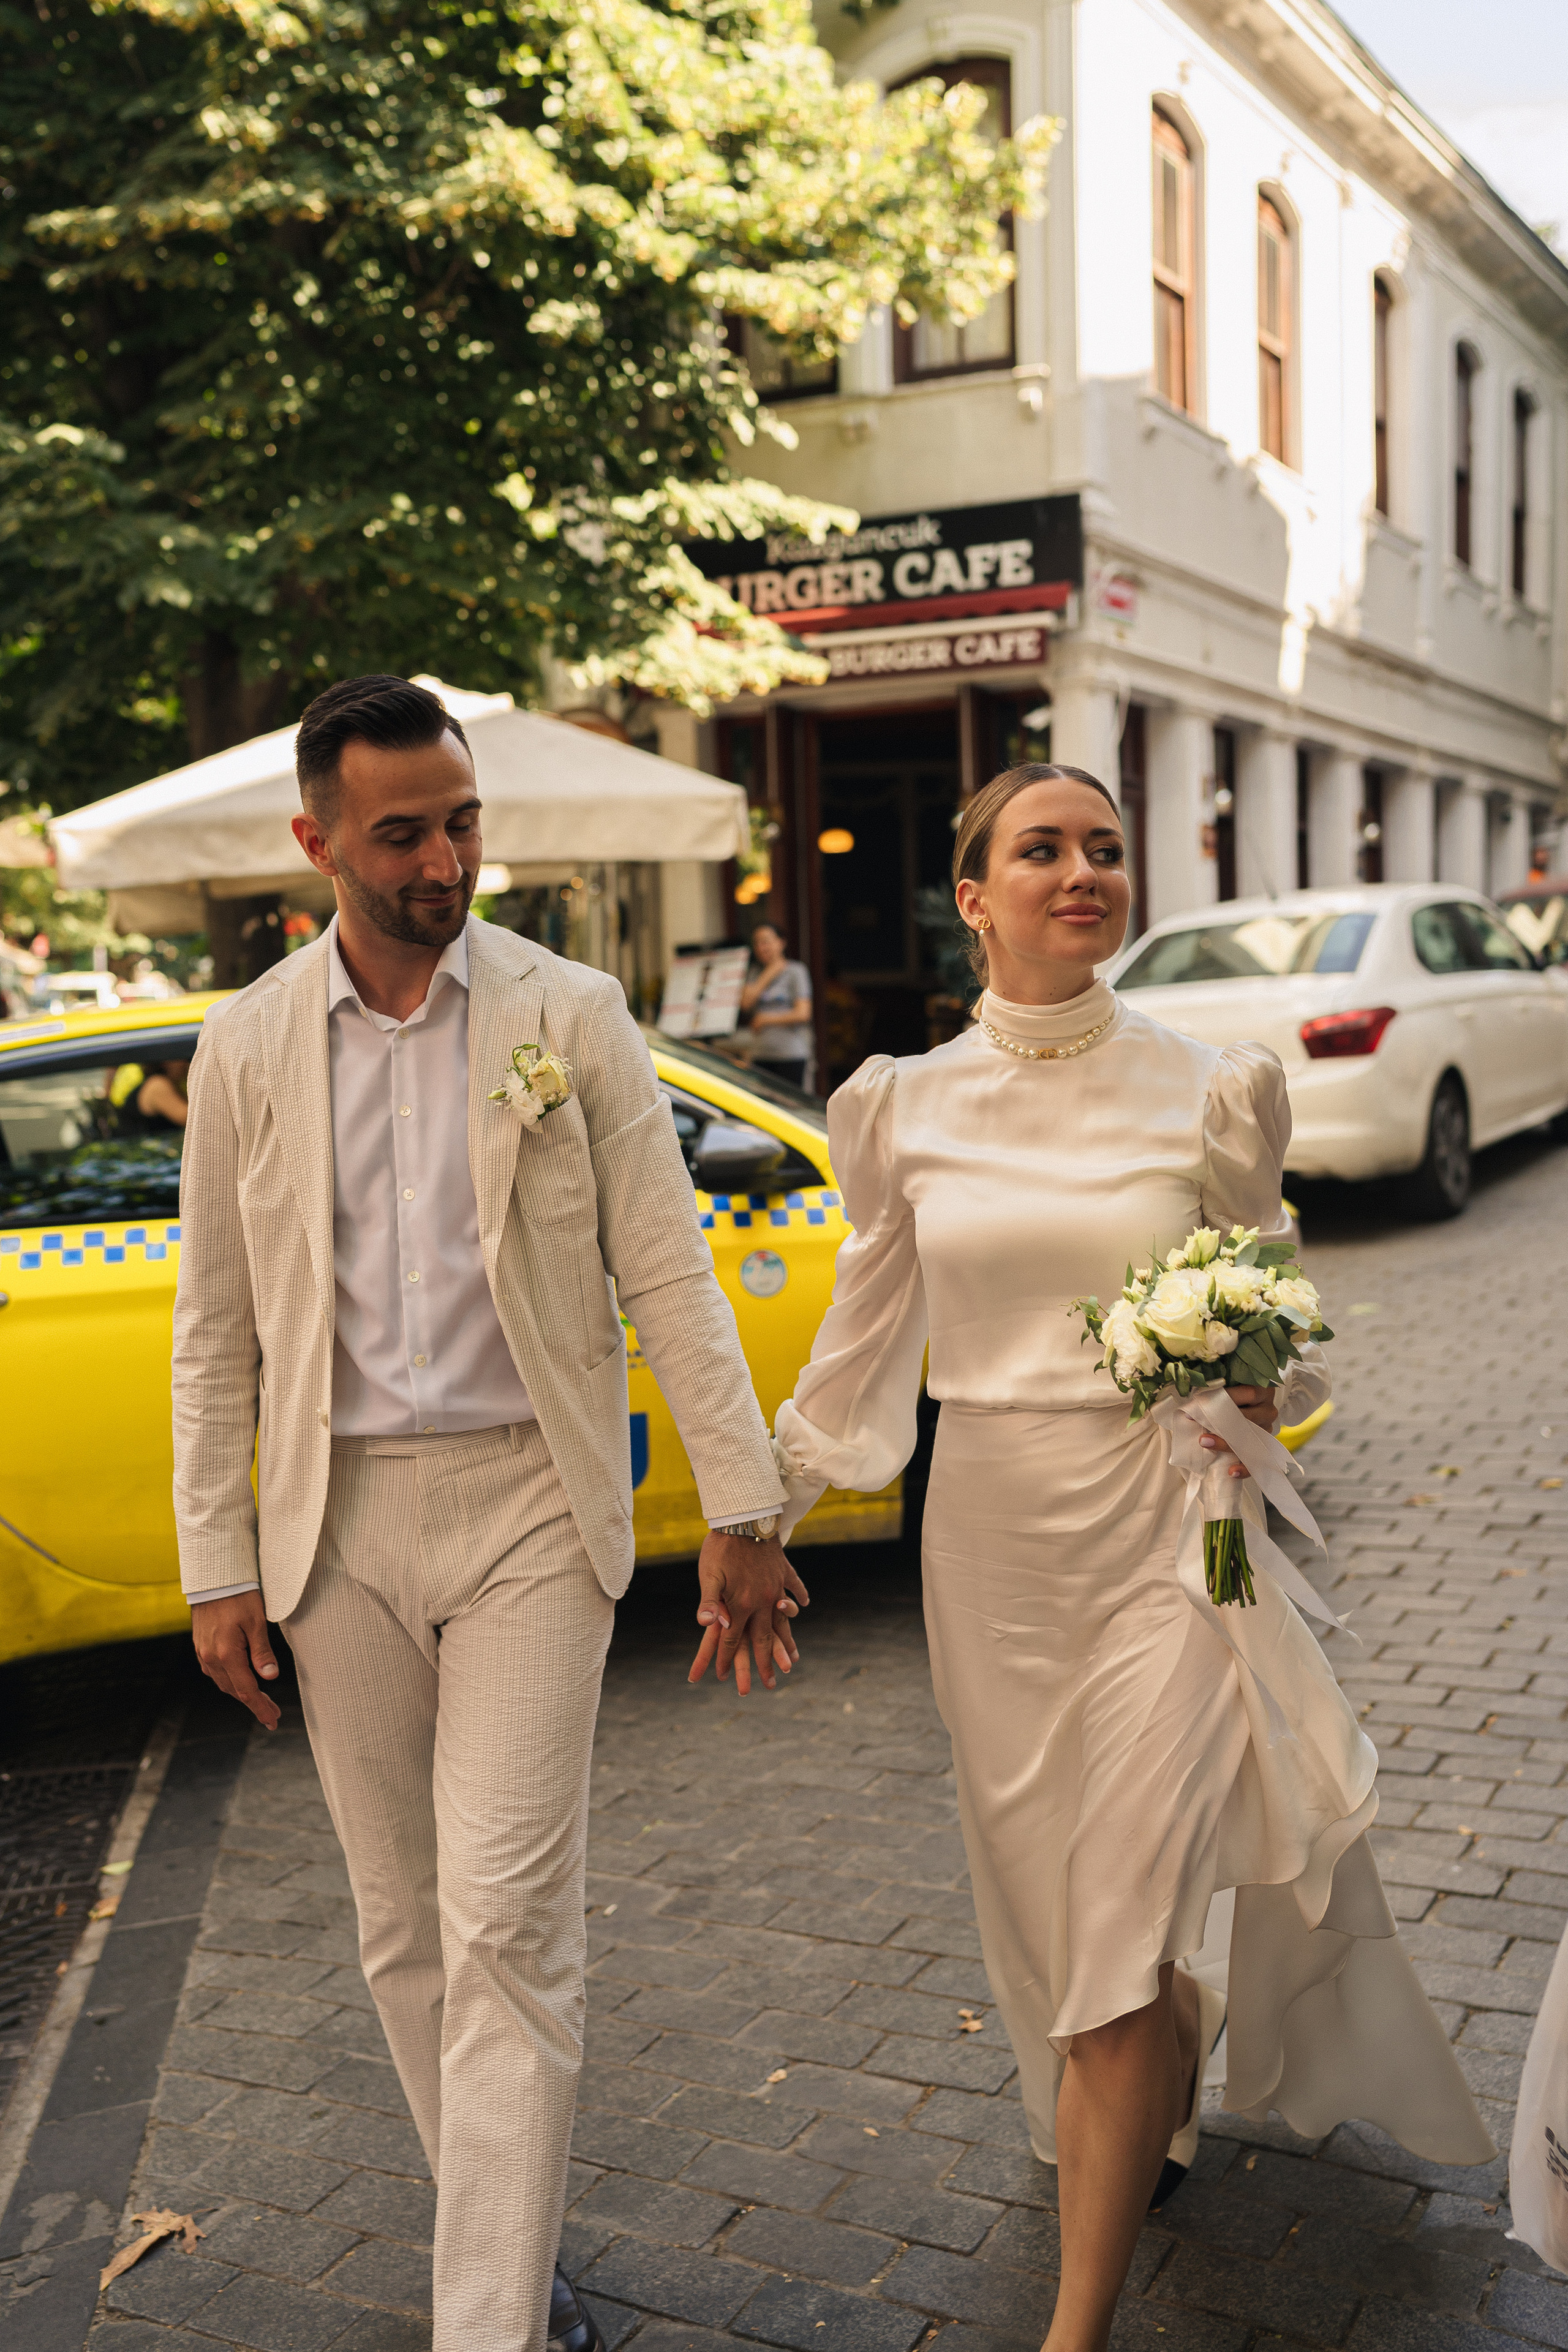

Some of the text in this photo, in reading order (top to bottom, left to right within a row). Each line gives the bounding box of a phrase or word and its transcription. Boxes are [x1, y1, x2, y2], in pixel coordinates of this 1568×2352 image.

[712, 539, 1035, 614] URGER CAFE
[828, 630, 1042, 677] BURGER CAFE
